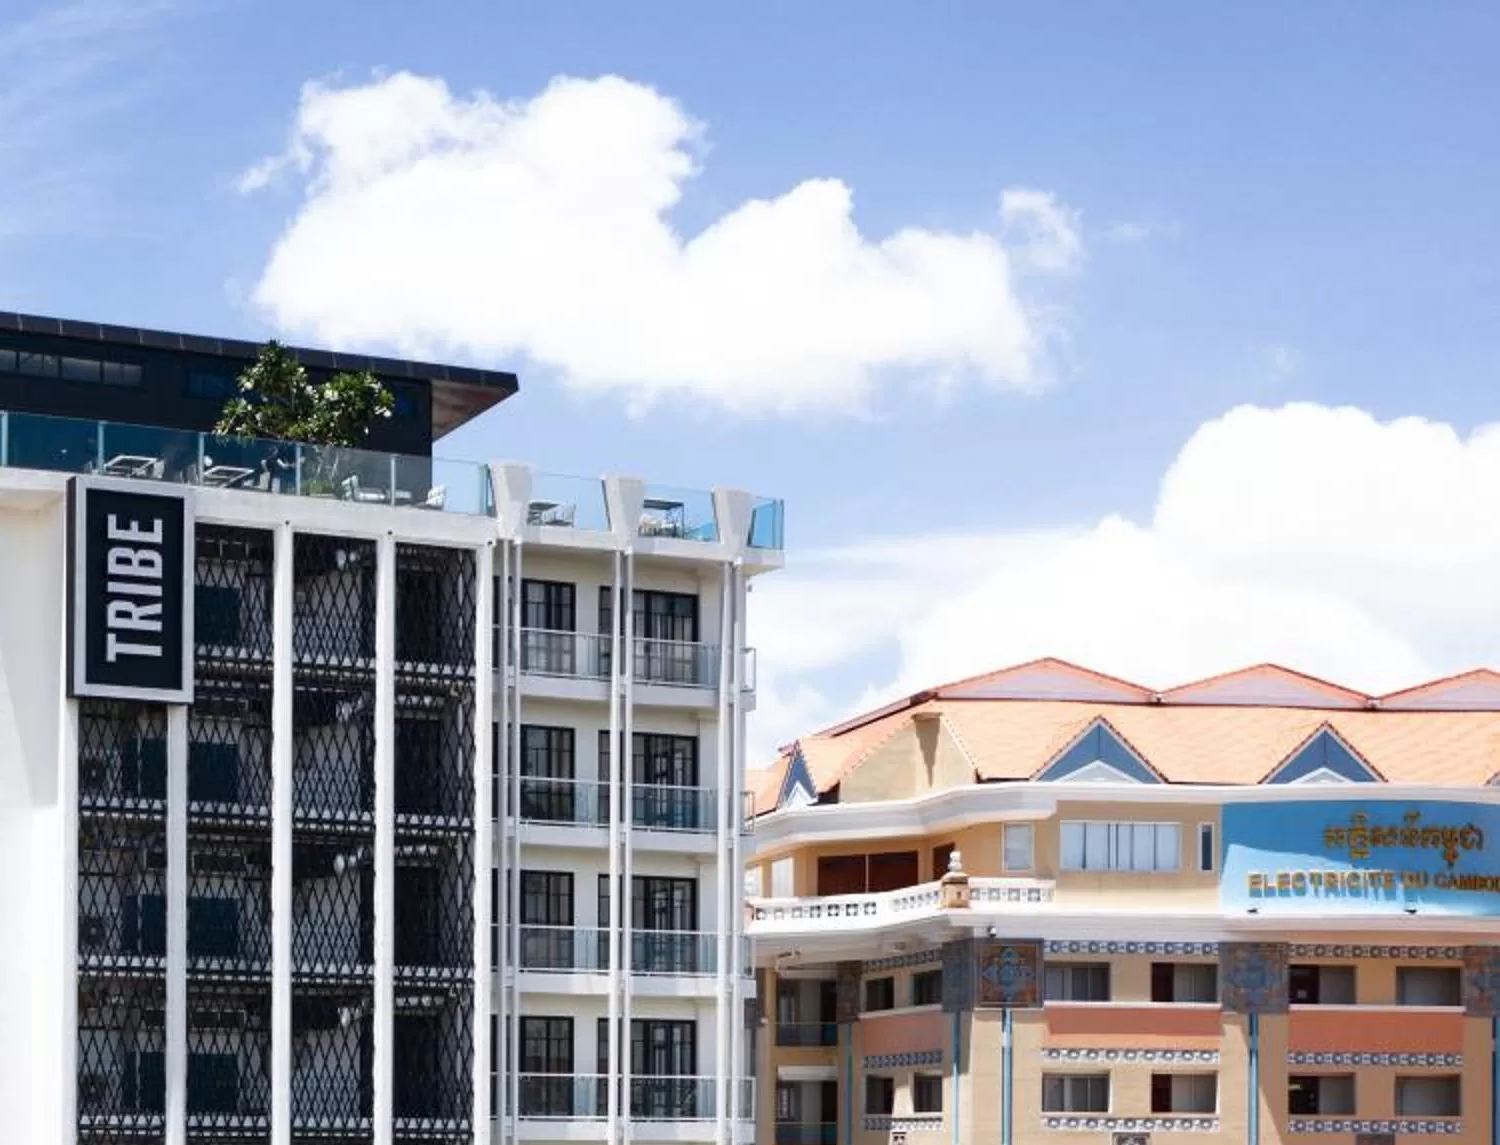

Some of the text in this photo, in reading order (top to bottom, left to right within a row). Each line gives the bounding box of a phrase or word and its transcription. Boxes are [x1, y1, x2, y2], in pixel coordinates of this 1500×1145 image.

[106, 512, 163, 664] TRIBE
[1248, 871, 1395, 891] ELECTRICITE
[1402, 871, 1429, 889] DU
